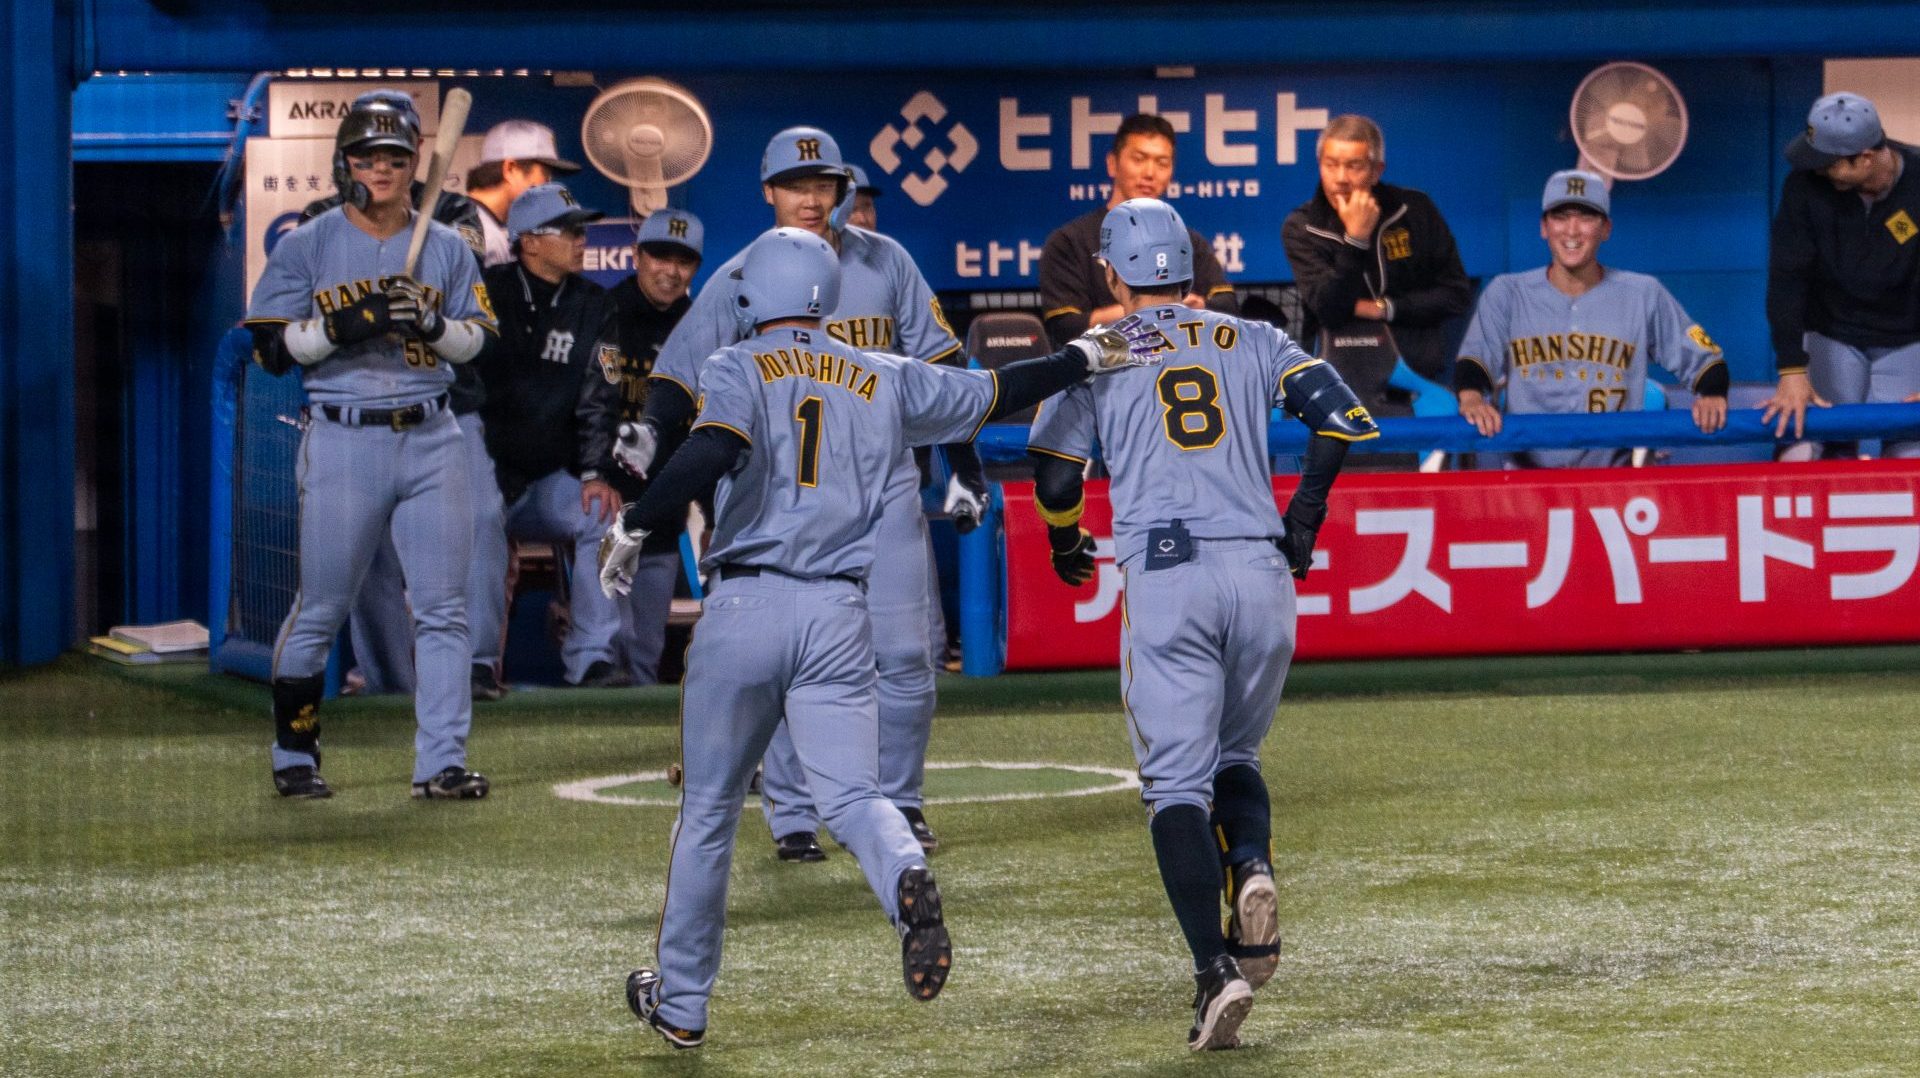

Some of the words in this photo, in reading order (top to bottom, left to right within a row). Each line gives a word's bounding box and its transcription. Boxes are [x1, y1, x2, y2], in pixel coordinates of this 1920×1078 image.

[1069, 179, 1260, 200] HITO-HITO
[1156, 252, 1167, 268] 8
[811, 285, 820, 300] 1
[1150, 321, 1237, 363] ATO
[1510, 332, 1636, 370] HANSHIN
[1156, 365, 1227, 451] 8
[795, 395, 824, 488] 1
[1075, 492, 1919, 623] スーパードラ
